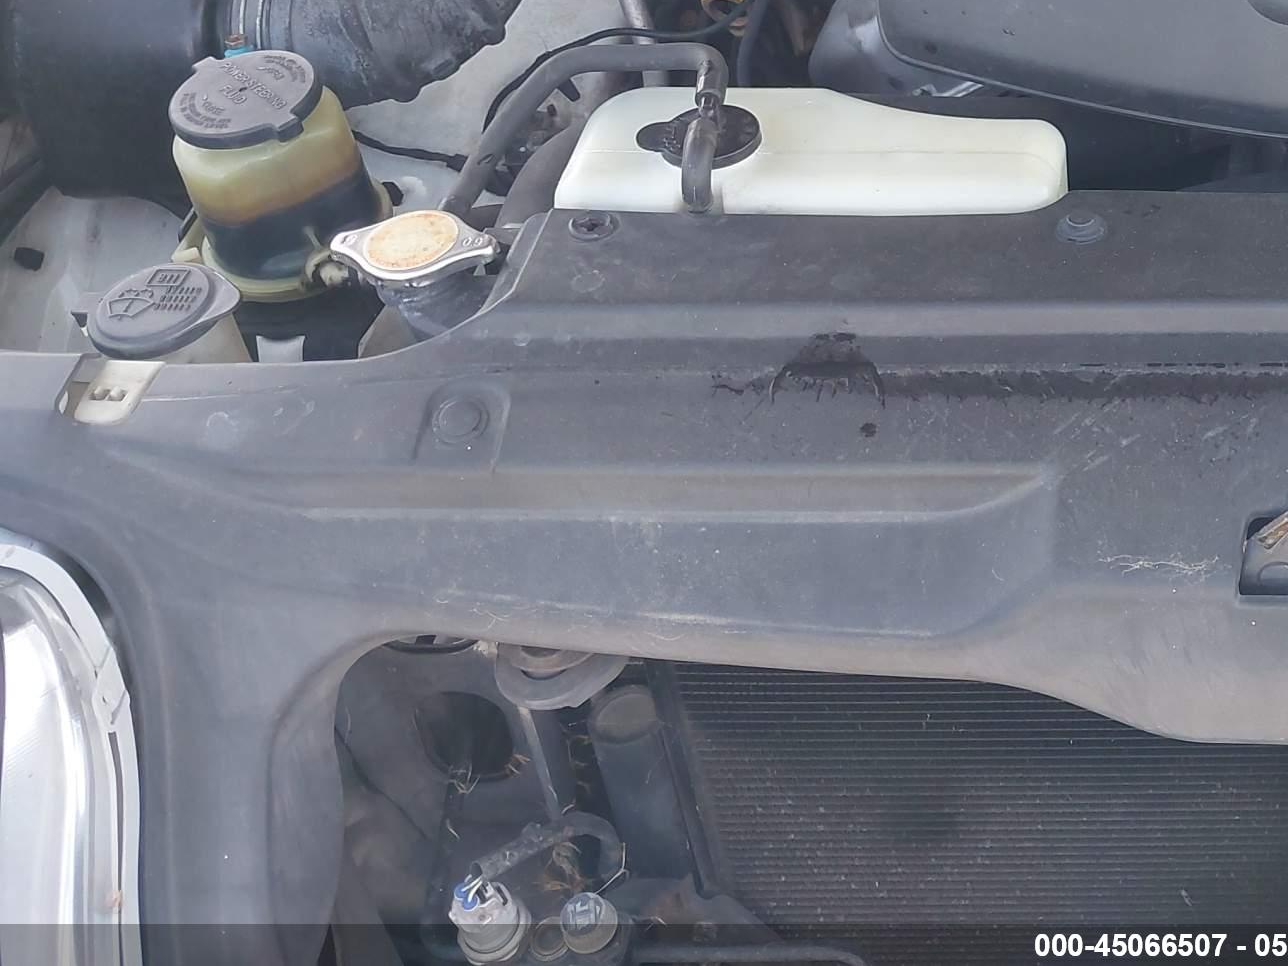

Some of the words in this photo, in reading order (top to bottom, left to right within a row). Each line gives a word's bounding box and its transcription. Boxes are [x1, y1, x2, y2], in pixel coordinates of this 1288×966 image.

[219, 62, 249, 83] POWER
[246, 78, 288, 110] STEERING
[219, 84, 248, 105] FLUID
